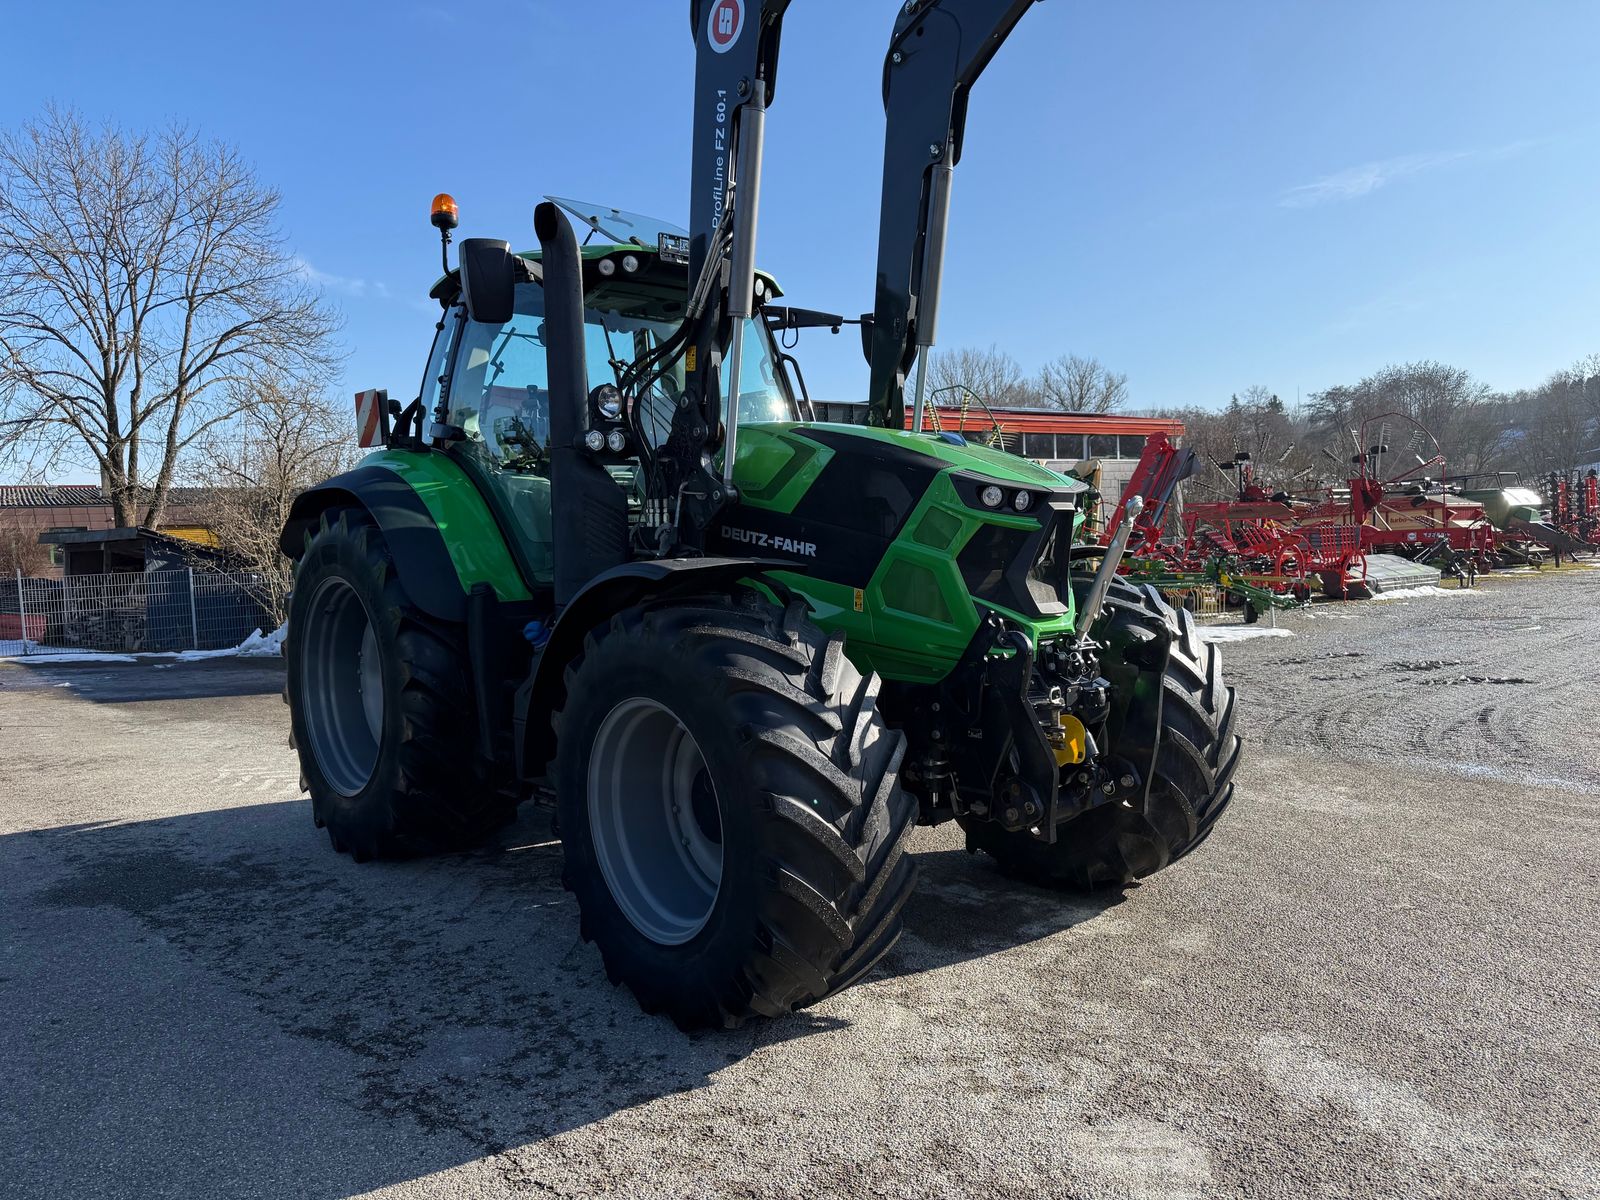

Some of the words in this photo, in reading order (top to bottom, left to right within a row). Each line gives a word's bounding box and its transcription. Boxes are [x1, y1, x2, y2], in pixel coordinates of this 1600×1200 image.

[716, 89, 727, 122] 60.1
[715, 127, 725, 151] FZ
[712, 156, 724, 229] ProfiLine
[721, 525, 817, 557] DEUTZ-FAHR
